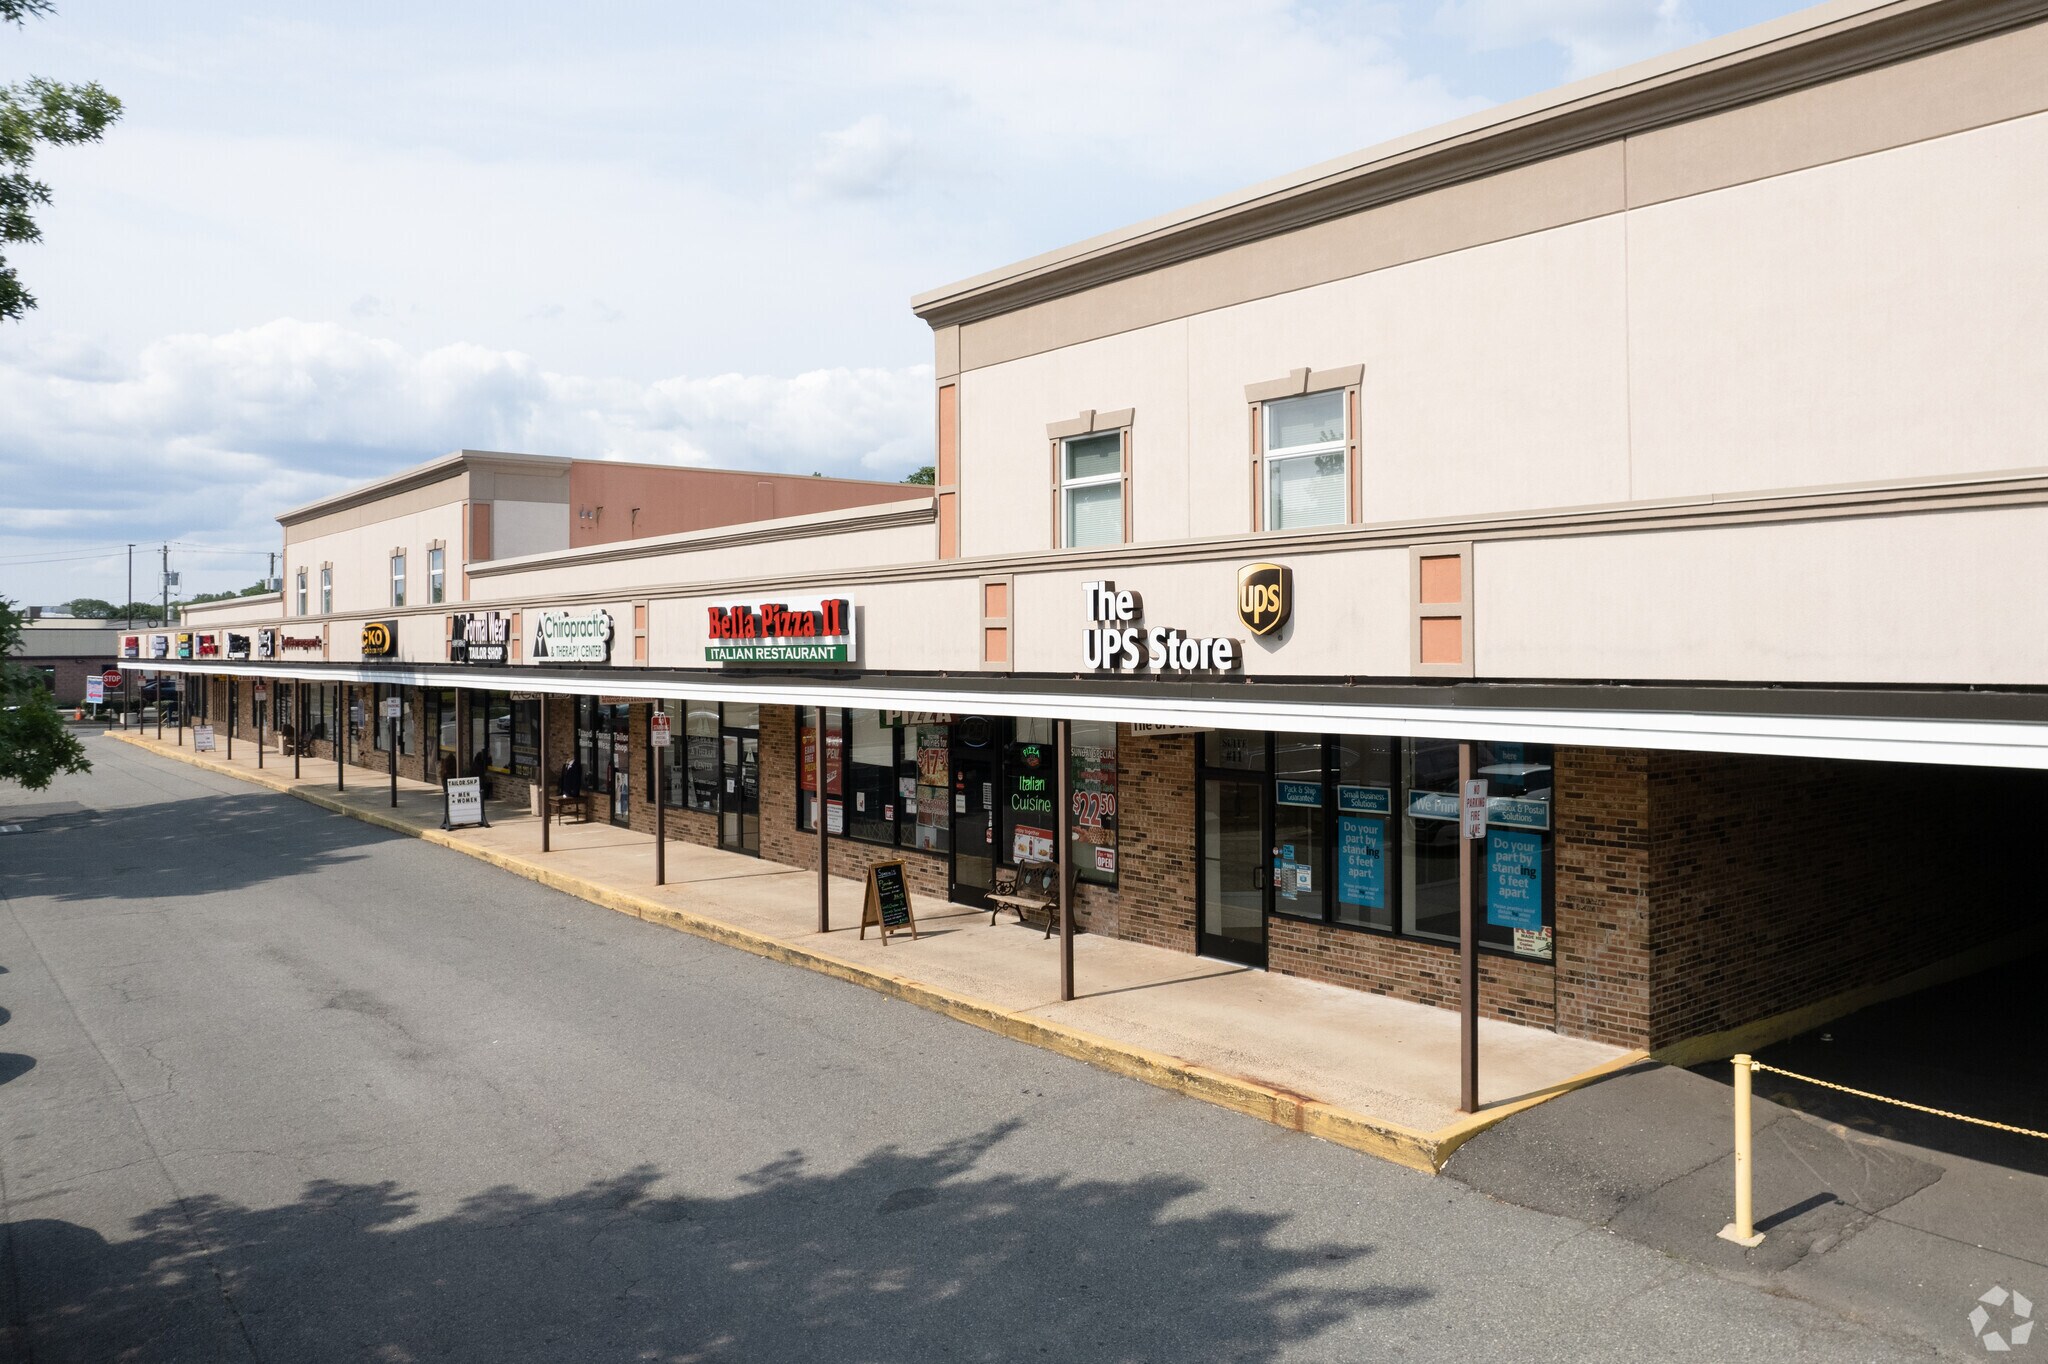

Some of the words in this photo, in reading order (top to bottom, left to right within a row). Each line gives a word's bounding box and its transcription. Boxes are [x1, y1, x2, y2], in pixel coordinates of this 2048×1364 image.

[1081, 580, 1134, 621] The
[1241, 584, 1280, 624] ups
[707, 606, 756, 639] Bella
[760, 604, 816, 638] Pizza
[821, 599, 841, 636] II
[464, 612, 488, 642] Formal
[488, 612, 506, 642] Wear
[544, 613, 605, 643] Chiropractic
[361, 630, 383, 646] CKO
[468, 647, 487, 660] TAILOR
[487, 647, 503, 660] SHOP
[551, 647, 555, 657] &
[556, 646, 580, 657] THERAPY
[581, 645, 602, 657] CENTER
[710, 648, 753, 660] ITALIAN
[756, 646, 836, 660] RESTAURANT
[1082, 628, 1140, 670] UPS
[1149, 626, 1233, 670] Store
[103, 675, 122, 683] STOP
[886, 710, 952, 726] PIZZA
[1222, 738, 1247, 749] SUITE
[1023, 747, 1040, 757] PIZZA
[1094, 749, 1115, 760] SPECIAL
[1226, 752, 1242, 762] #11
[1503, 751, 1517, 761] here
[1019, 776, 1045, 792] Italian
[1284, 785, 1298, 794] Pack
[1304, 786, 1316, 796] Ship
[1473, 784, 1480, 794] NO
[1287, 793, 1314, 803] Guarantee
[1343, 790, 1359, 799] Small
[1360, 791, 1385, 801] Business
[1011, 794, 1051, 813] Cuisine
[1351, 798, 1377, 809] Solutions
[1416, 797, 1431, 810] We
[1434, 800, 1457, 813] Print
[1467, 797, 1485, 808] PARKING
[1470, 810, 1480, 821] FIRE
[1517, 804, 1523, 813] &
[1525, 805, 1545, 815] Postal
[1502, 811, 1532, 822] Solutions
[1344, 821, 1356, 832] Do
[1358, 825, 1378, 835] your
[1469, 823, 1480, 834] LANE
[1345, 834, 1363, 844] part
[1365, 835, 1376, 848] by
[1493, 838, 1508, 849] Do
[1510, 841, 1535, 853] your
[1342, 844, 1380, 859] standing
[1097, 856, 1113, 869] OPEN
[1348, 855, 1354, 865] 6
[1356, 856, 1374, 868] feet
[1495, 852, 1519, 863] part
[1520, 853, 1532, 867] by
[1348, 867, 1374, 879] apart.
[1492, 862, 1536, 879] standing
[1499, 874, 1506, 885] 6
[1508, 876, 1529, 888] feet
[1499, 886, 1529, 899] apart.
